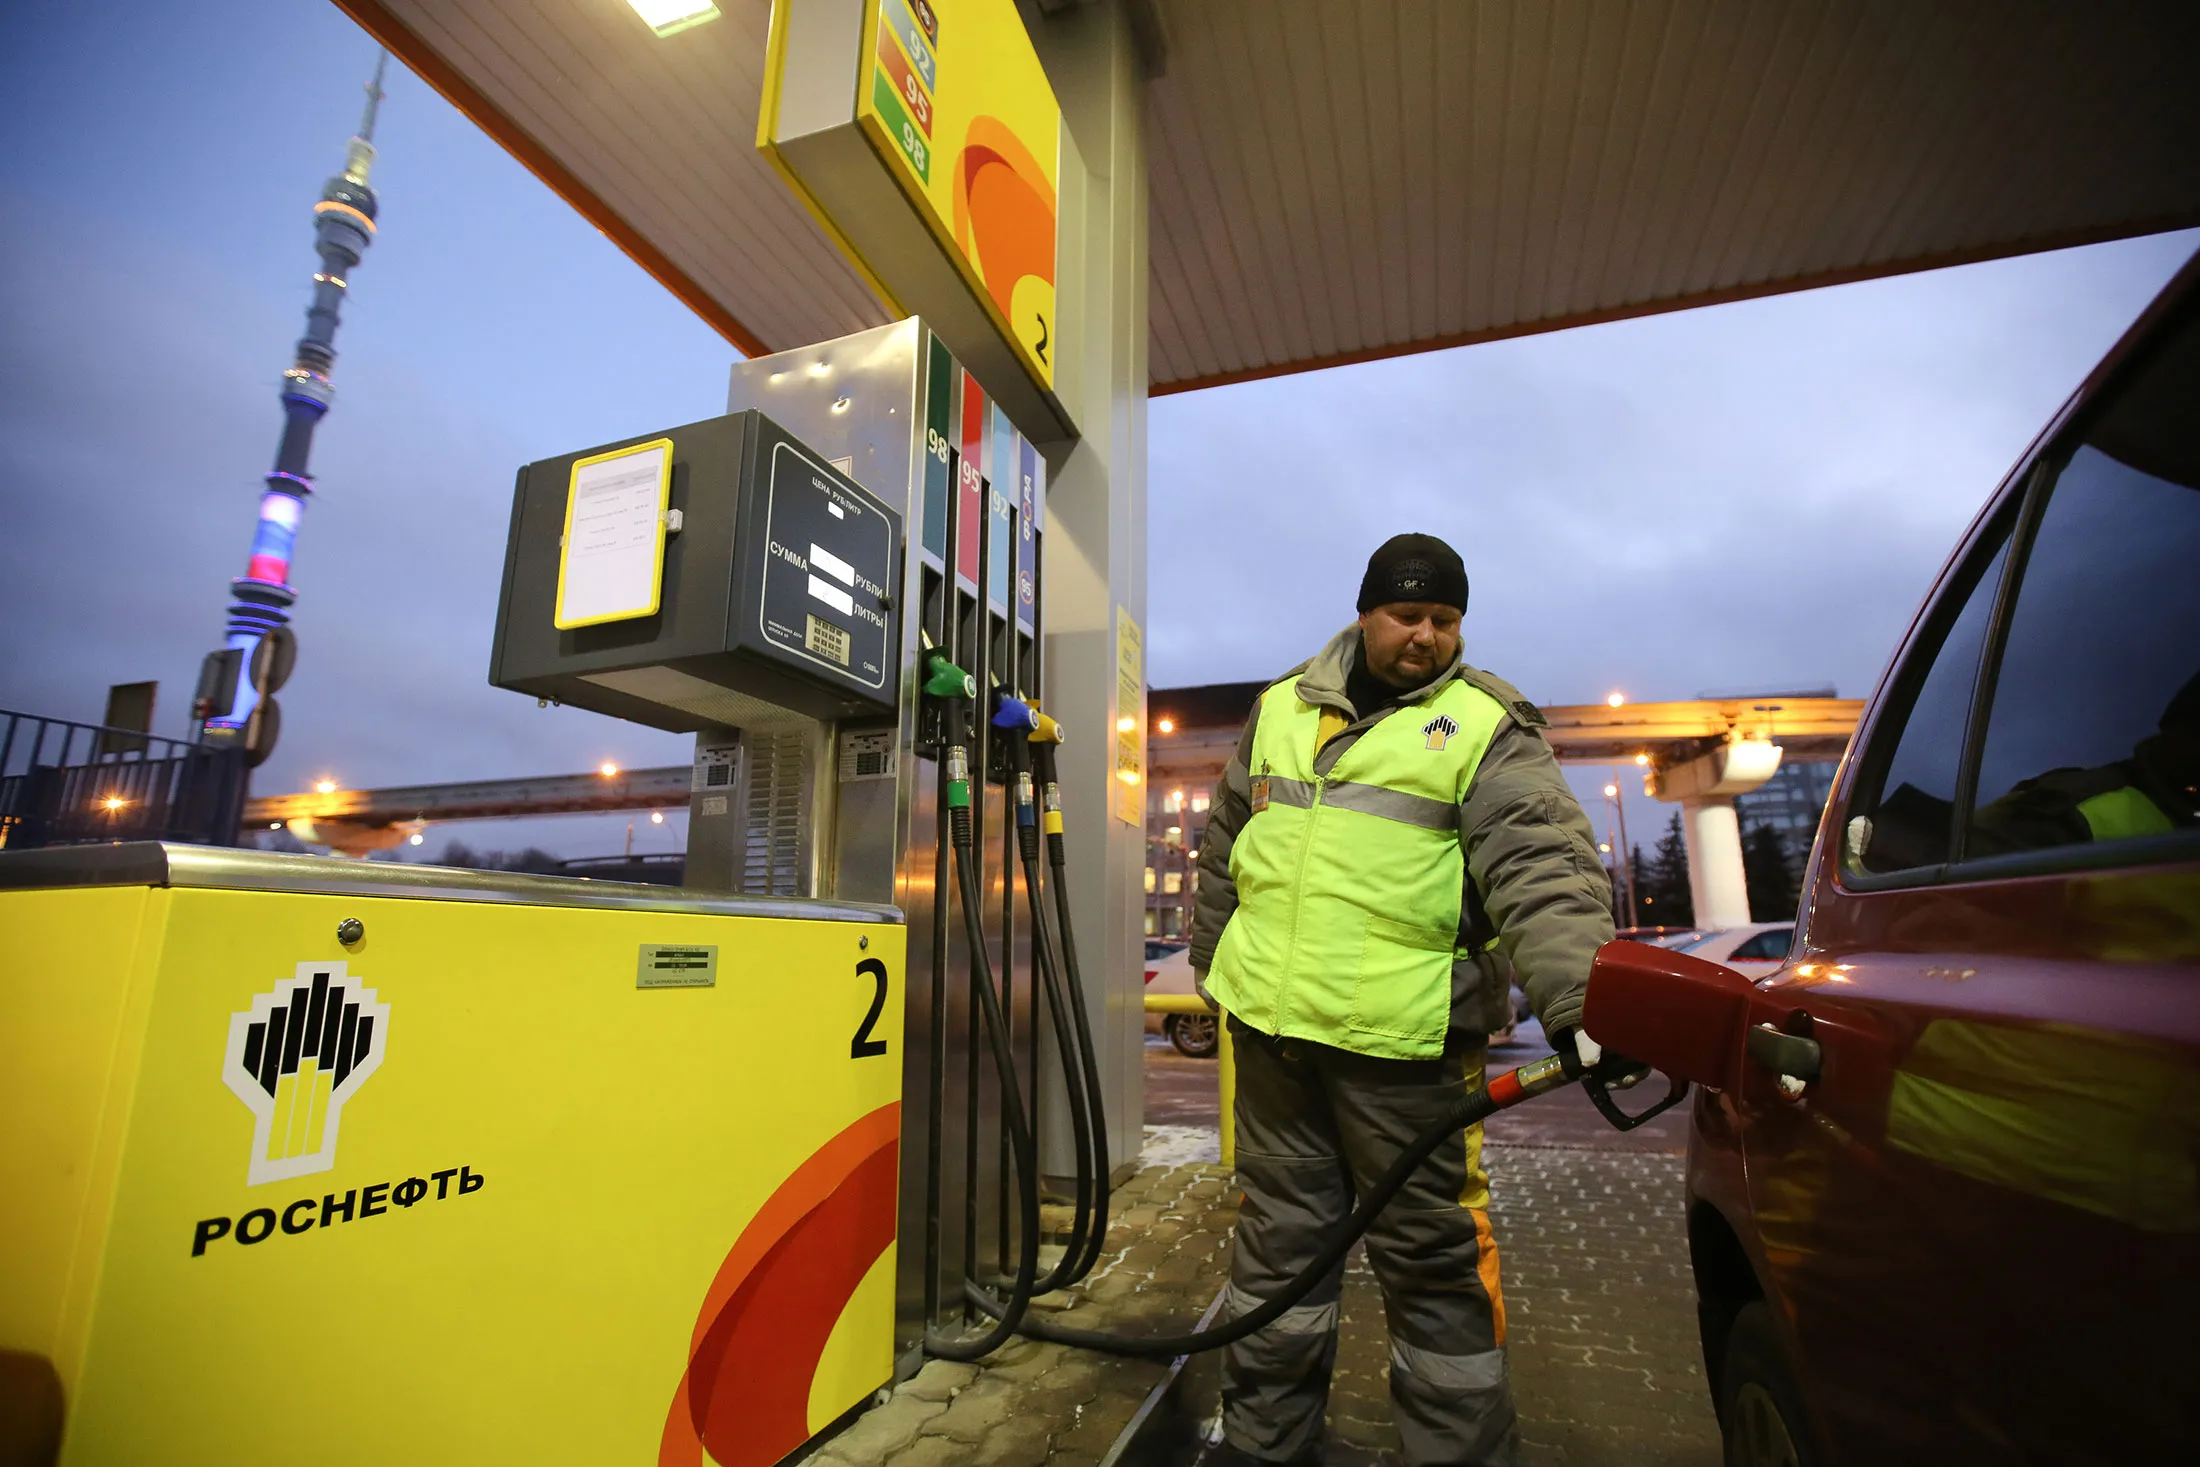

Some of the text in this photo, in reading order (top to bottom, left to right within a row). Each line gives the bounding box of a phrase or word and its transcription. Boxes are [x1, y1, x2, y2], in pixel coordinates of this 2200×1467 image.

[910, 30, 930, 81] 92
[906, 74, 928, 124] 95
[903, 122, 925, 172] 98
[1035, 313, 1049, 367] 2
[928, 427, 948, 464] 98
[812, 476, 831, 496] ЦЕНА
[962, 461, 980, 493] 95
[992, 490, 1008, 521] 92
[770, 541, 808, 572] СУММА
[855, 574, 883, 599] РУБЛИ
[854, 603, 884, 628] ЛИТРЫ
[851, 957, 888, 1059] 2
[191, 1165, 485, 1257] РОСНЕФТЬ
